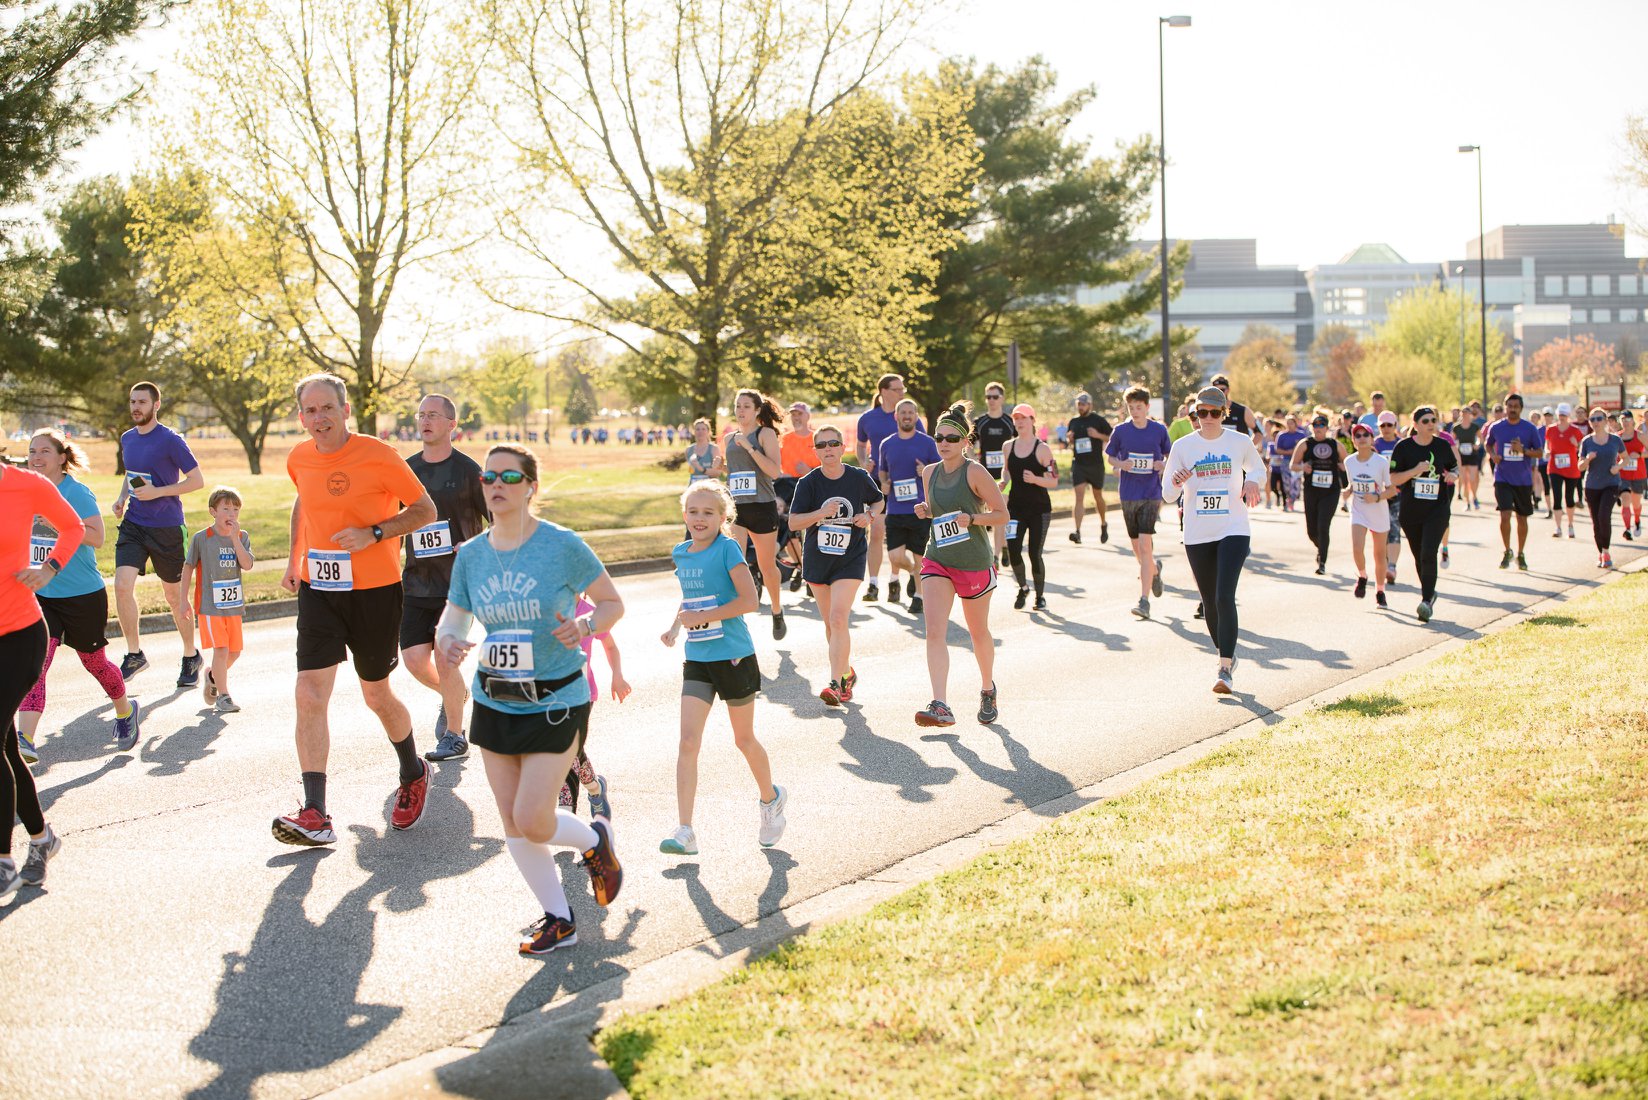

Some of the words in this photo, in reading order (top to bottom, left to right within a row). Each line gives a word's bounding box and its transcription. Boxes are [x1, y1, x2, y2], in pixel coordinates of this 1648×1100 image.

[1134, 460, 1148, 468] 133
[735, 478, 750, 490] 178
[898, 485, 912, 496] 621
[1421, 484, 1434, 494] 191
[1203, 496, 1222, 510] 597
[939, 521, 959, 538] 180
[420, 531, 442, 548] 485
[824, 532, 844, 548] 302
[316, 562, 340, 580] 298
[221, 587, 238, 602] 325
[478, 571, 537, 604] UNDER
[477, 598, 541, 624] ARMOUR
[488, 644, 518, 668] 055
